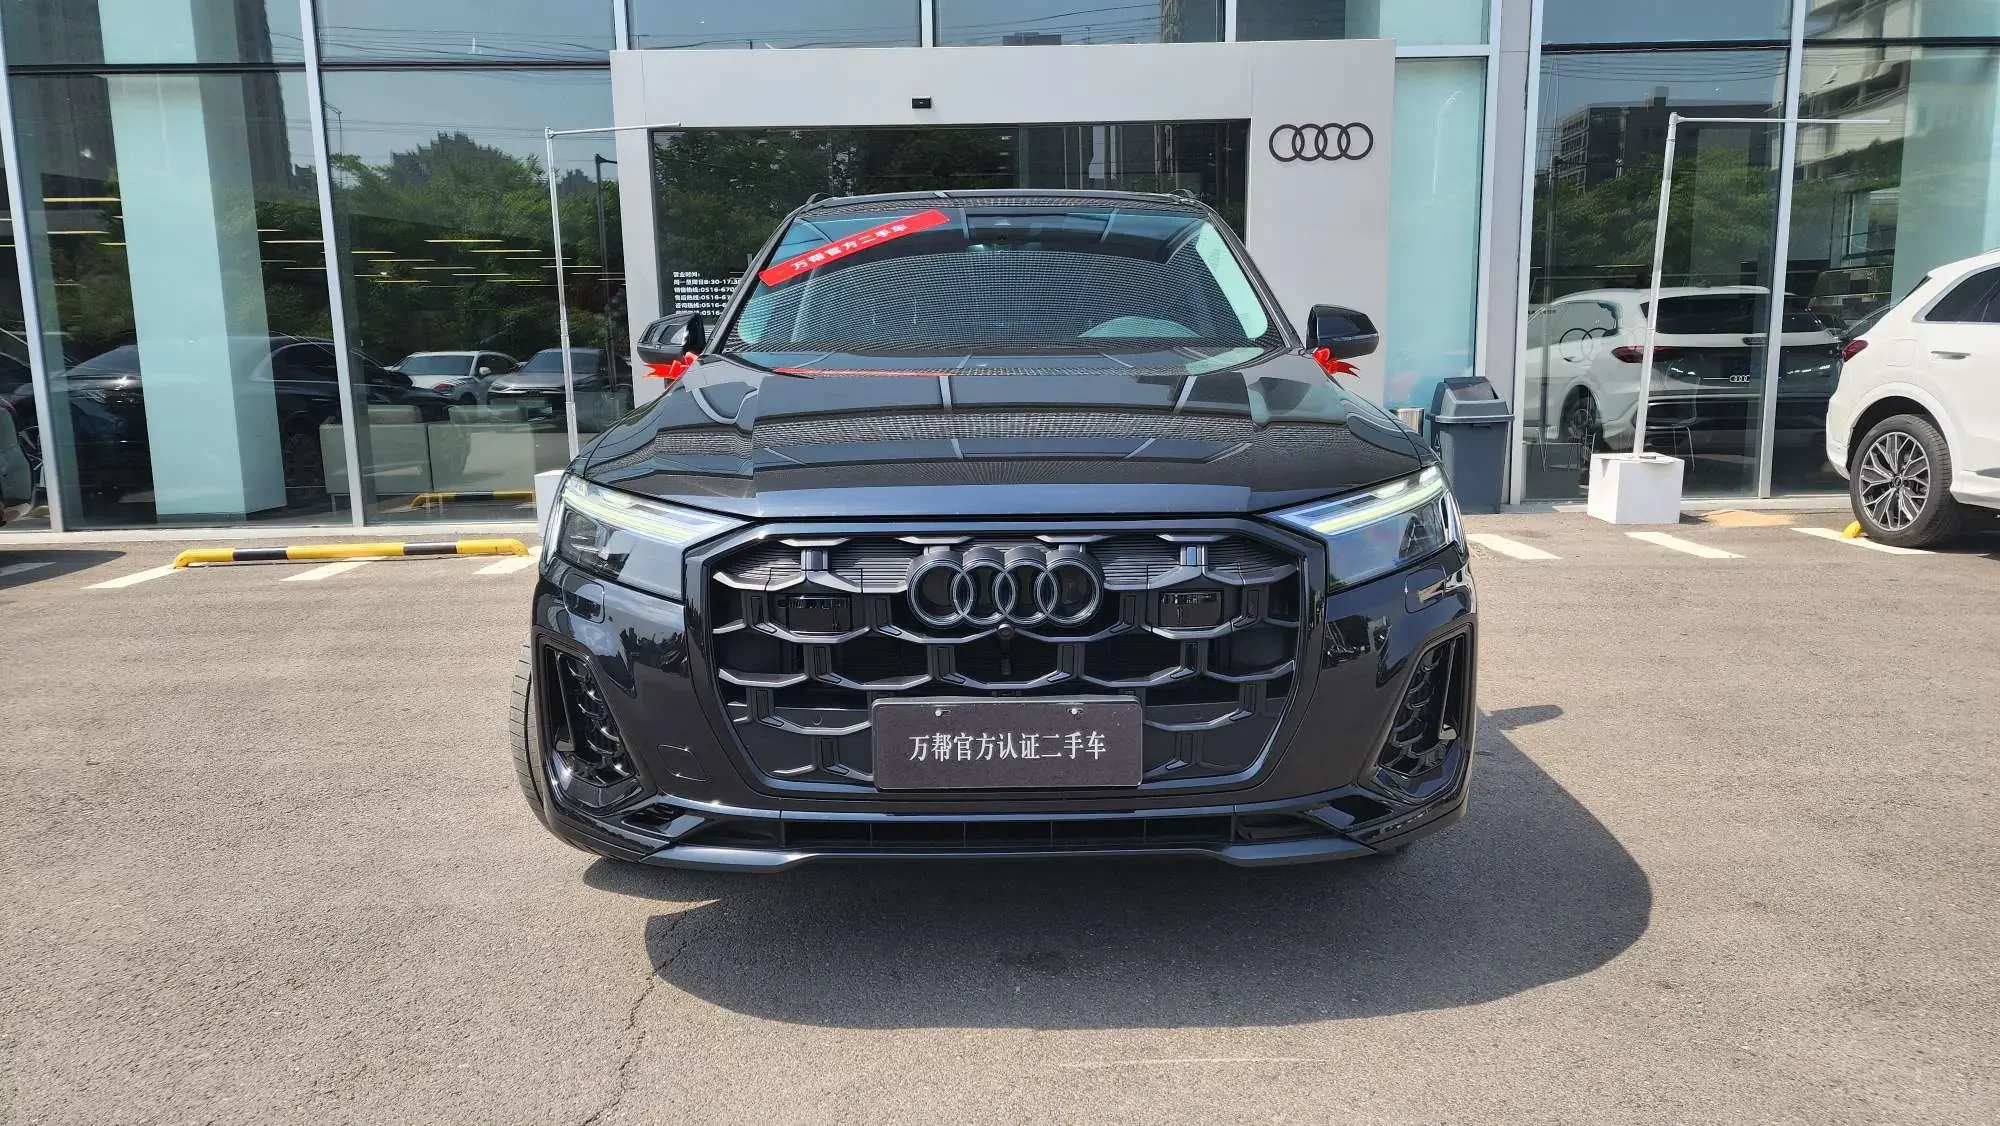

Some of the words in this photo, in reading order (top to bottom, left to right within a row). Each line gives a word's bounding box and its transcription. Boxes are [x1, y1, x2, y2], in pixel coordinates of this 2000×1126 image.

[791, 224, 909, 271] 万帮官方二手车
[908, 731, 1107, 762] 万帮官方认证二手车
